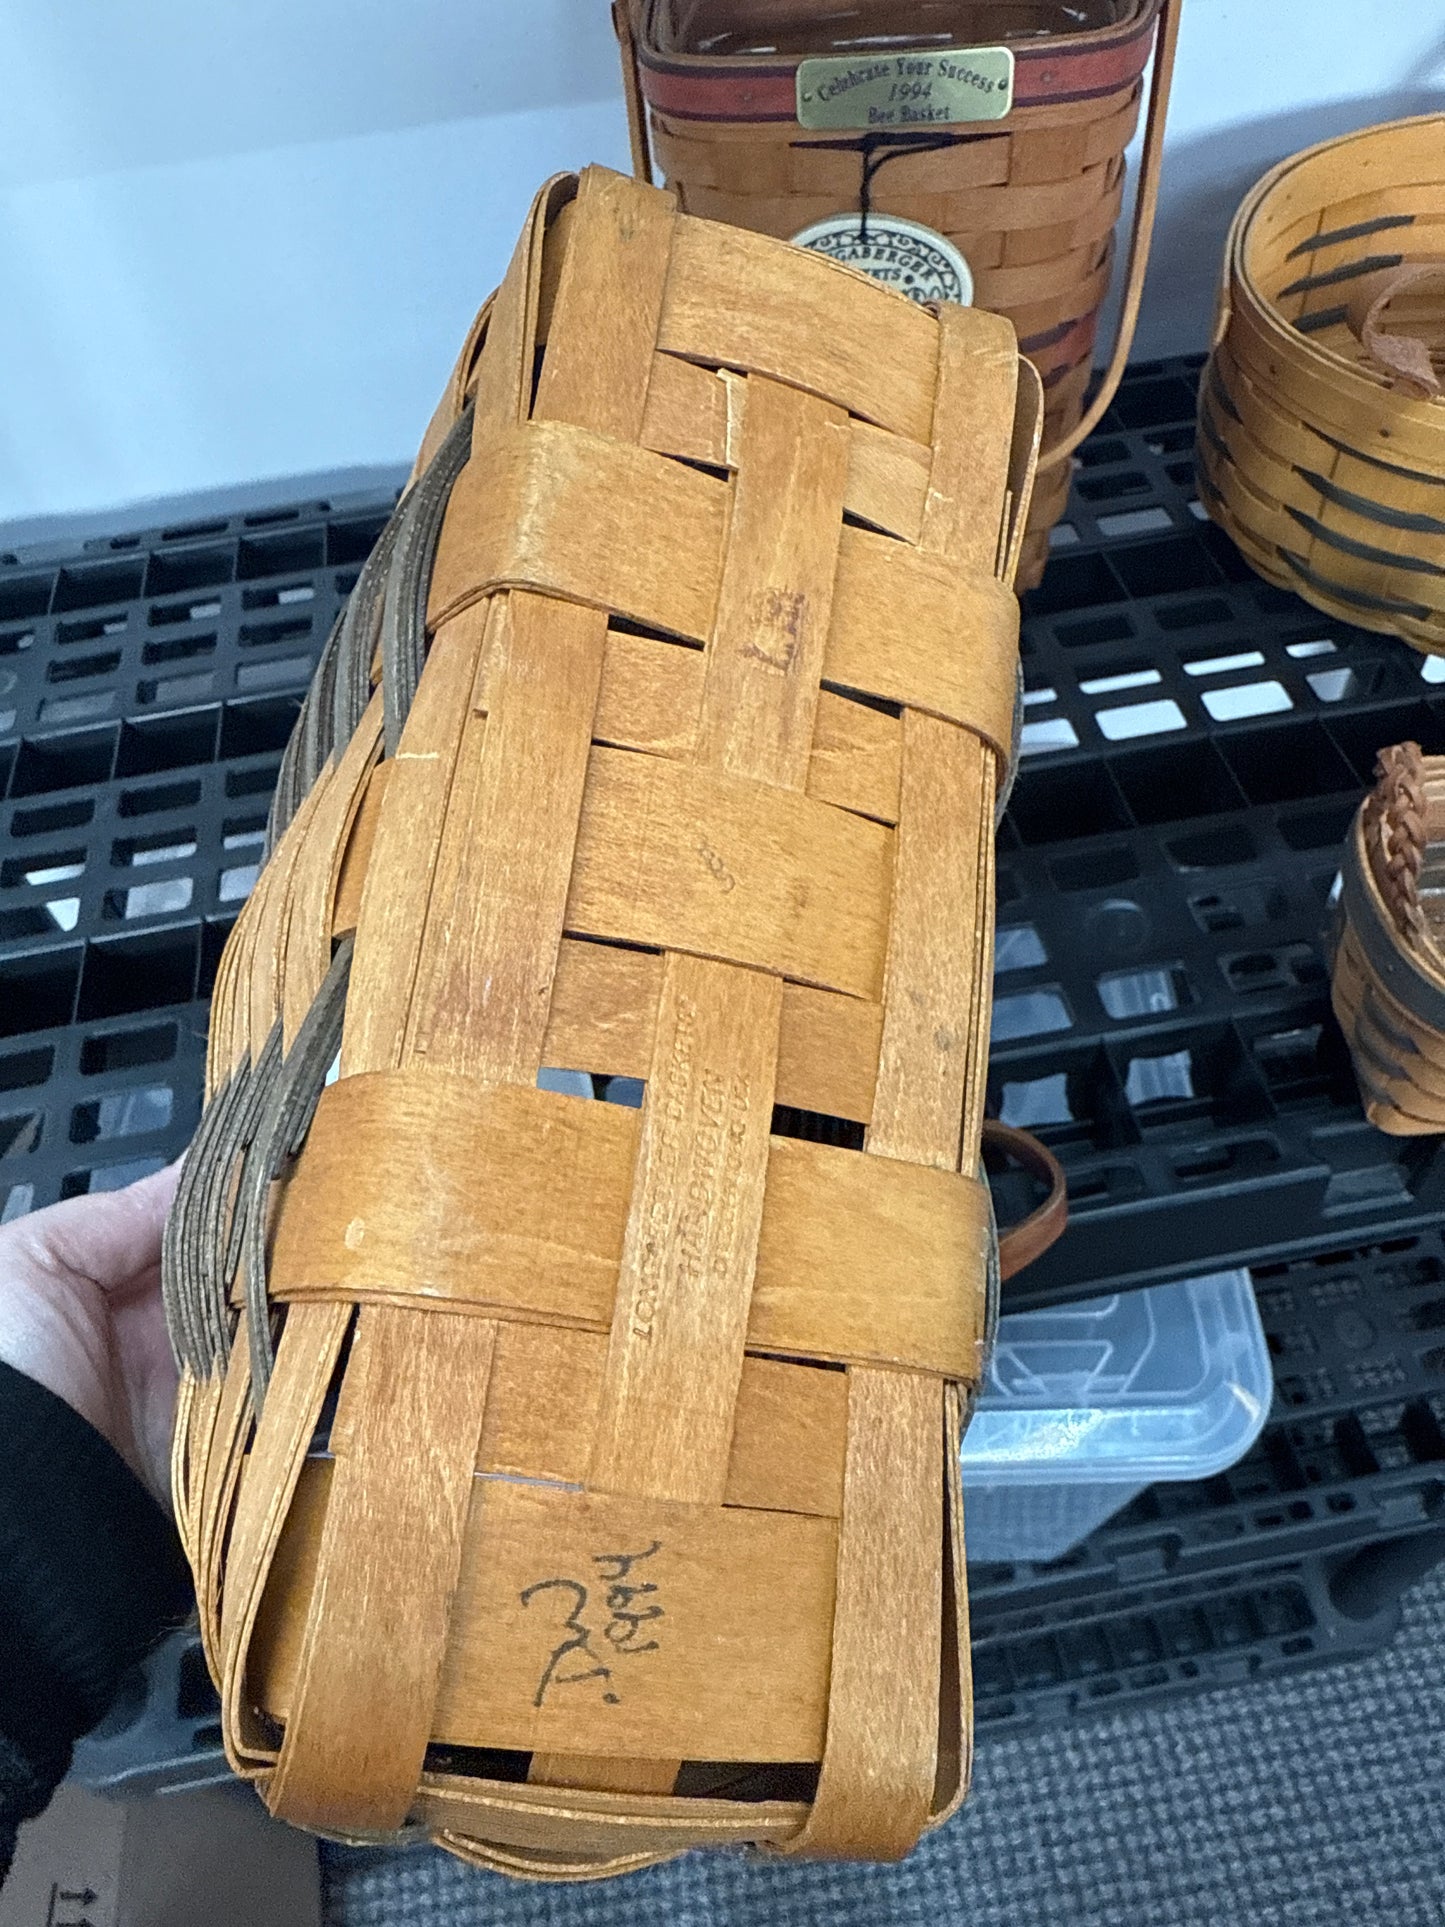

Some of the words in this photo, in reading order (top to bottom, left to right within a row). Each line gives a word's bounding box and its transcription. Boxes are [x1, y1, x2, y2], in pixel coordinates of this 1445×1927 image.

[816, 62, 890, 102] Celebrate
[896, 57, 933, 76] Your
[938, 58, 996, 94] Success
[888, 82, 933, 101] 1994
[867, 106, 895, 124] Bee
[901, 104, 951, 122] Basket
[829, 247, 937, 281] GABERGER
[592, 1540, 665, 1653] 1994
